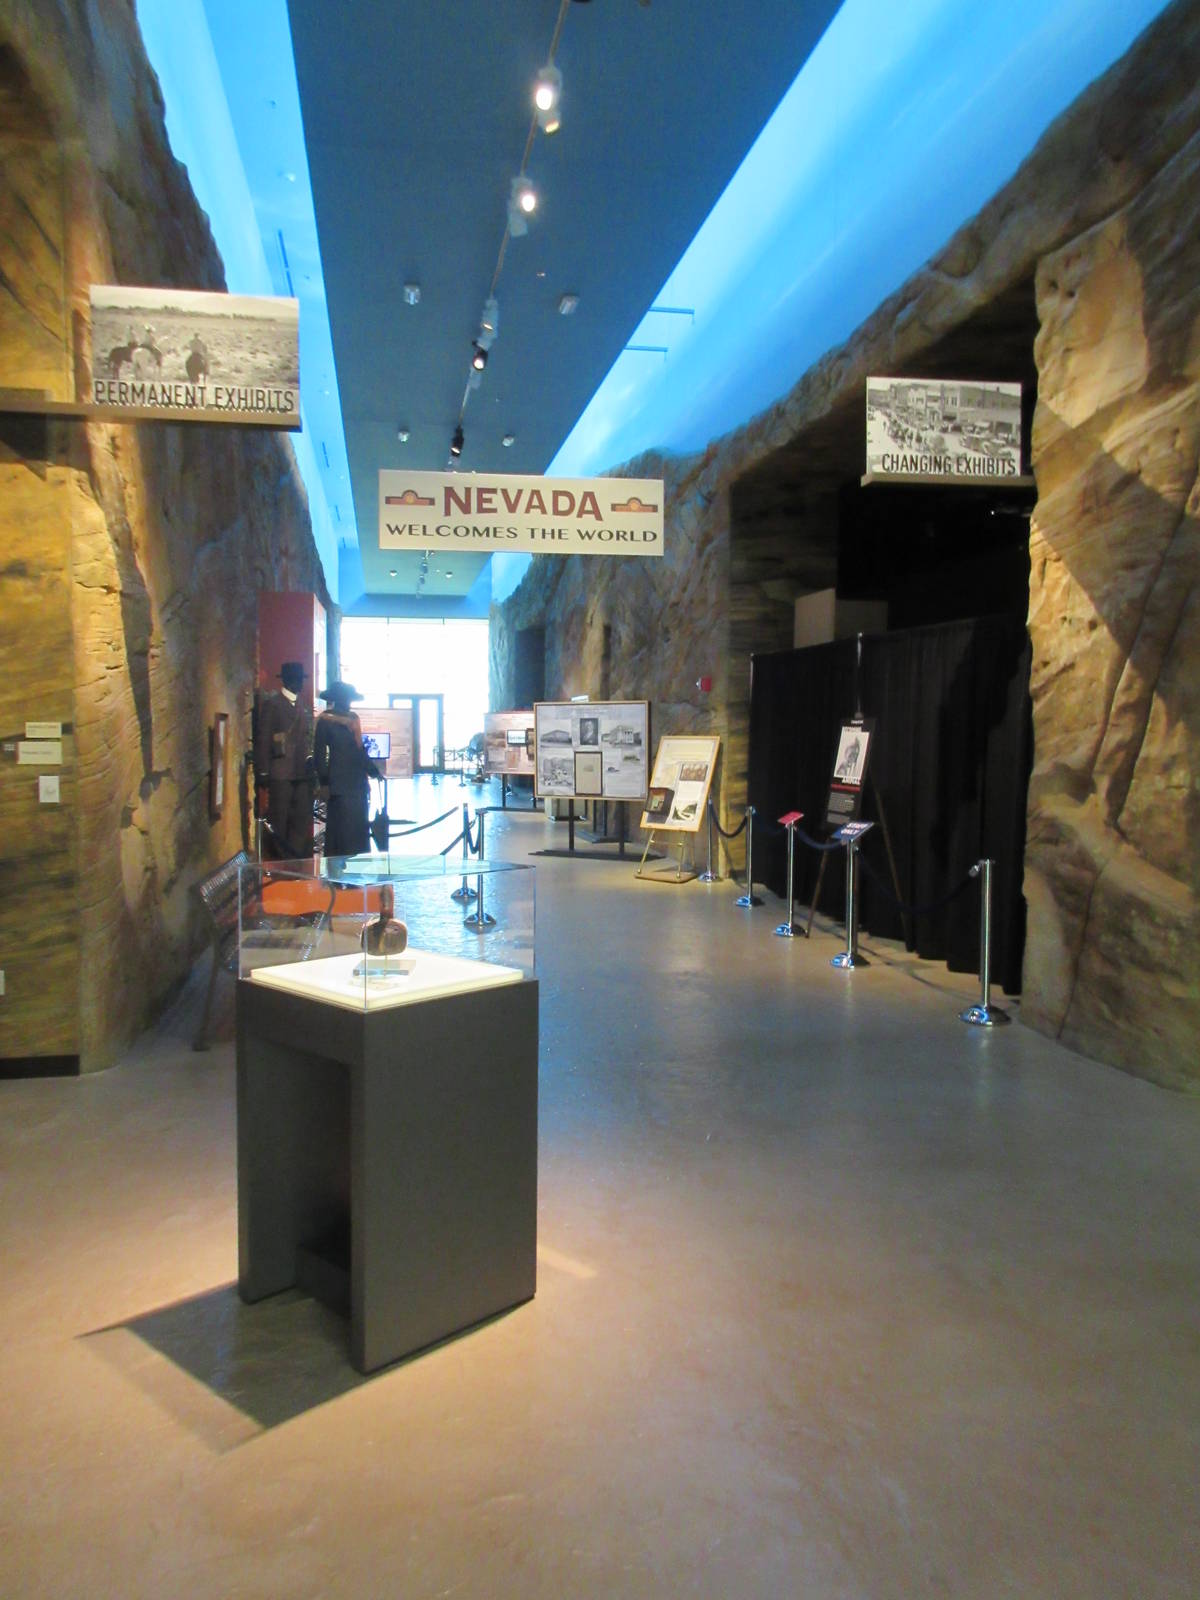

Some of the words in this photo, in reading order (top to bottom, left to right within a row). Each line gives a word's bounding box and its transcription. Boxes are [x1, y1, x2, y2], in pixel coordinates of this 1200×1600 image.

[95, 380, 206, 407] PERMANENT
[214, 386, 294, 412] EXHIBITS
[882, 453, 951, 474] CHANGING
[956, 456, 1016, 475] EXHIBITS
[443, 486, 603, 522] NEVADA
[386, 523, 518, 540] WELCOMES
[527, 527, 569, 541] THE
[576, 529, 657, 543] WORLD
